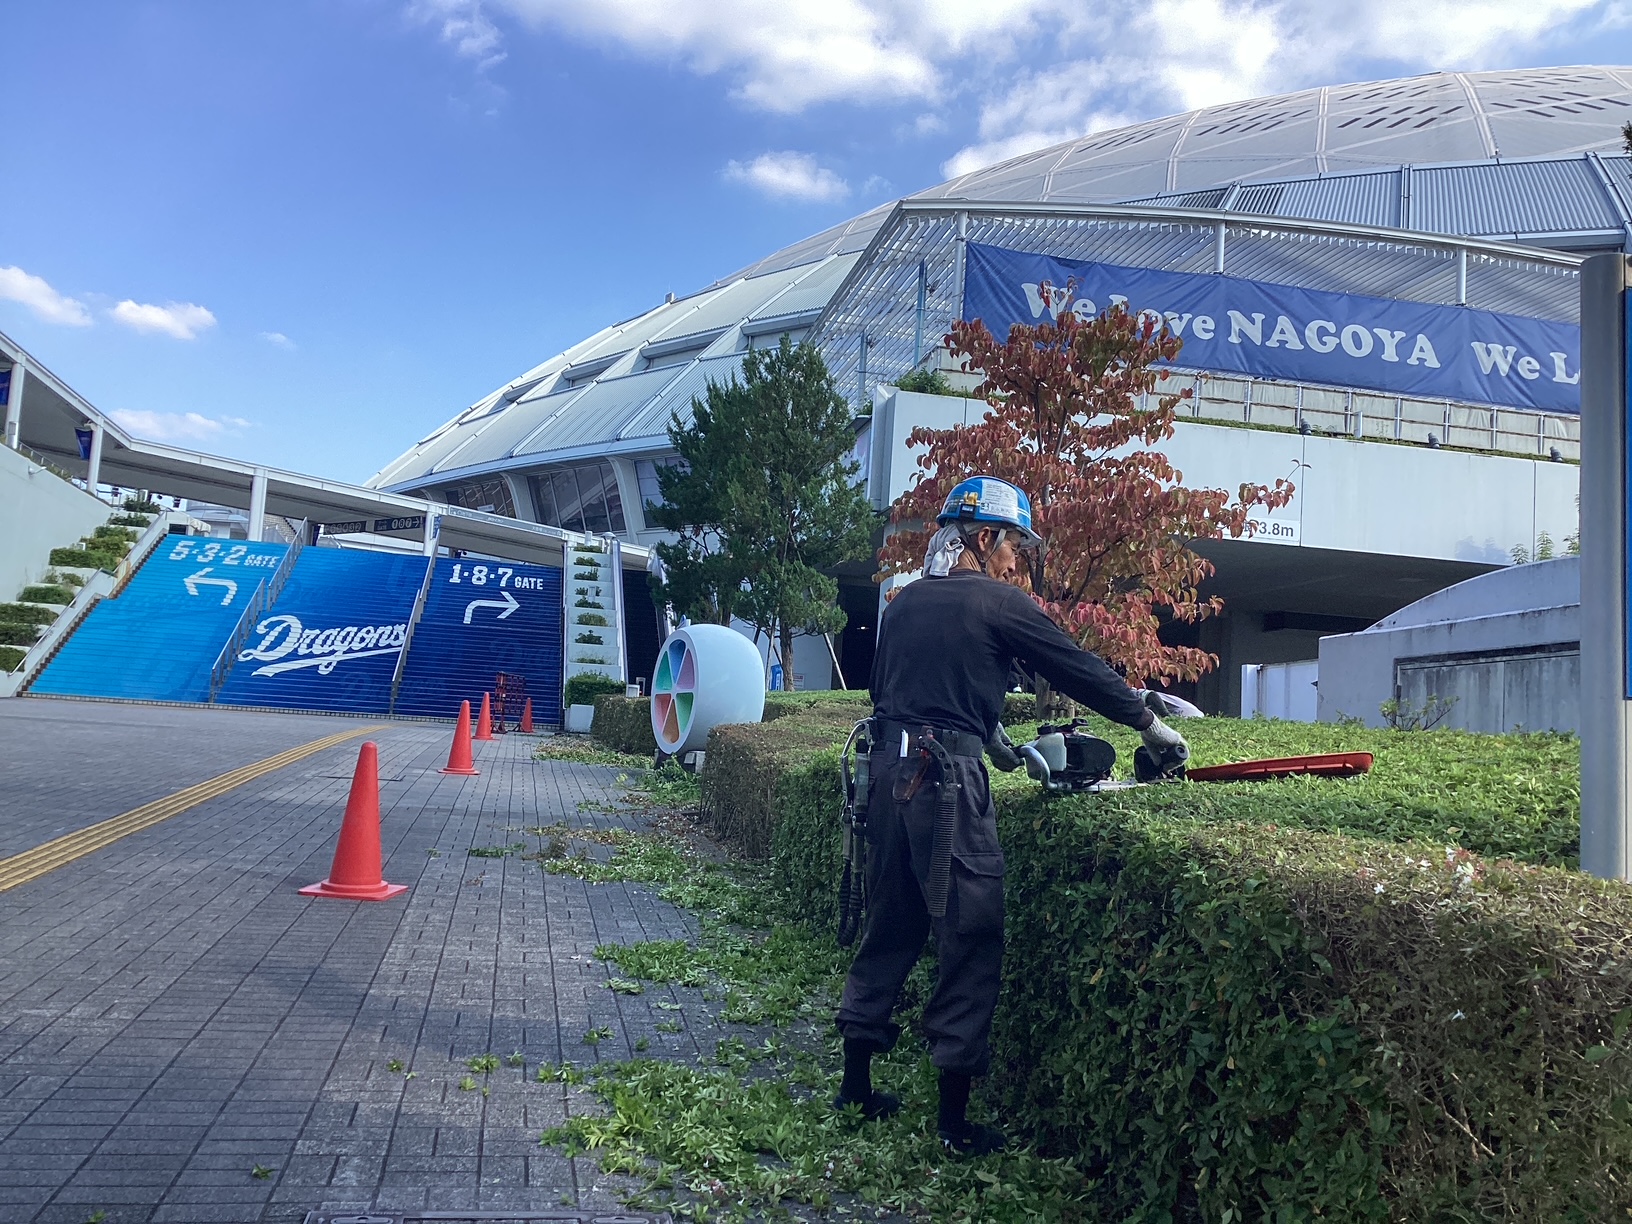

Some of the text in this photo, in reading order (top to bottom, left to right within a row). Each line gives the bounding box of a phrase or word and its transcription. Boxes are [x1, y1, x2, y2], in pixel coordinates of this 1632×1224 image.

[1021, 283, 1096, 322] We
[1226, 310, 1441, 368] NAGOYA
[1470, 341, 1580, 385] We L
[1259, 521, 1294, 537] 3.8m
[244, 554, 280, 568] GATE
[514, 576, 544, 590] GATE
[237, 614, 407, 676] Dragons
